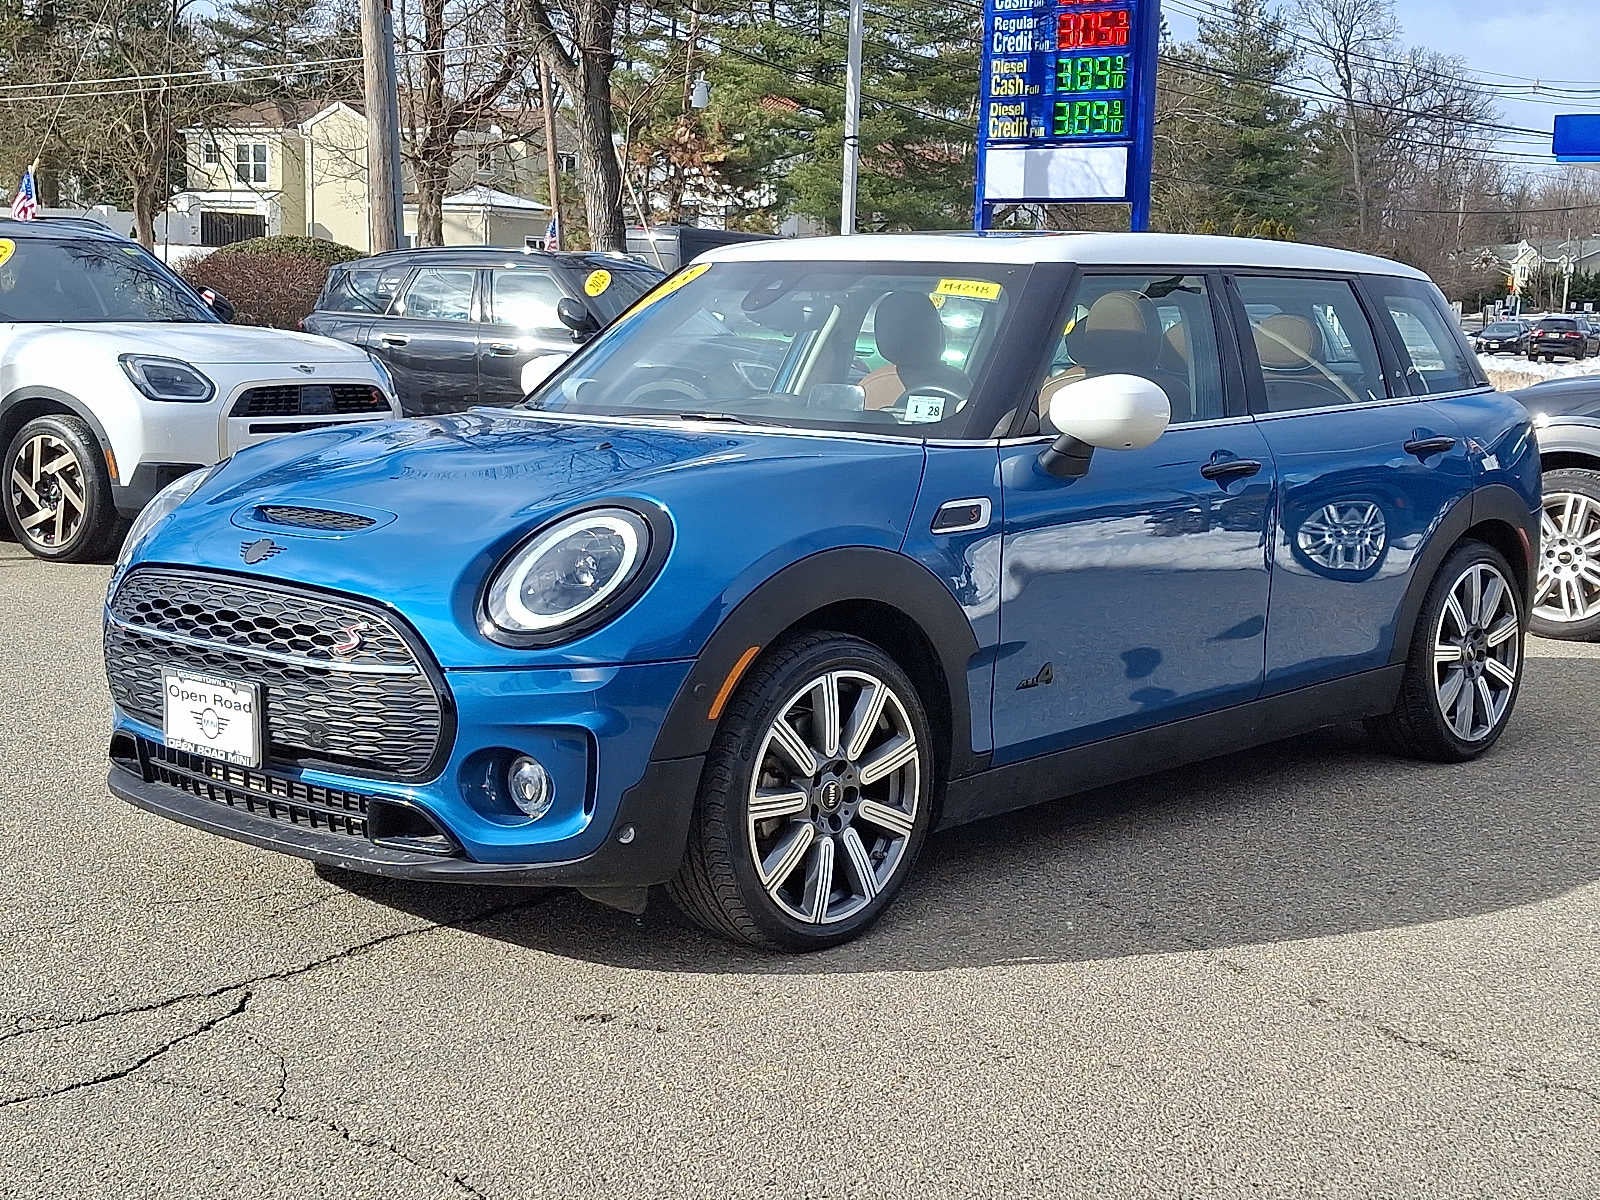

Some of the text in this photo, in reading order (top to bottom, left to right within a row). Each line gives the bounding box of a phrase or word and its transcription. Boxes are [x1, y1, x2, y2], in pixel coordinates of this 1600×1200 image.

[994, 16, 1038, 33] Regular
[993, 31, 1033, 53] Credit
[991, 59, 1027, 74] Diesel
[991, 75, 1040, 96] Cash Full
[990, 102, 1025, 117] Diesel
[988, 116, 1029, 138] Credit
[370, 391, 379, 404] S
[913, 404, 940, 417] 1 28
[969, 508, 978, 521] S
[333, 621, 370, 654] S
[169, 684, 252, 714] Open Road
[168, 739, 252, 768] OPEN ROAD MINI
